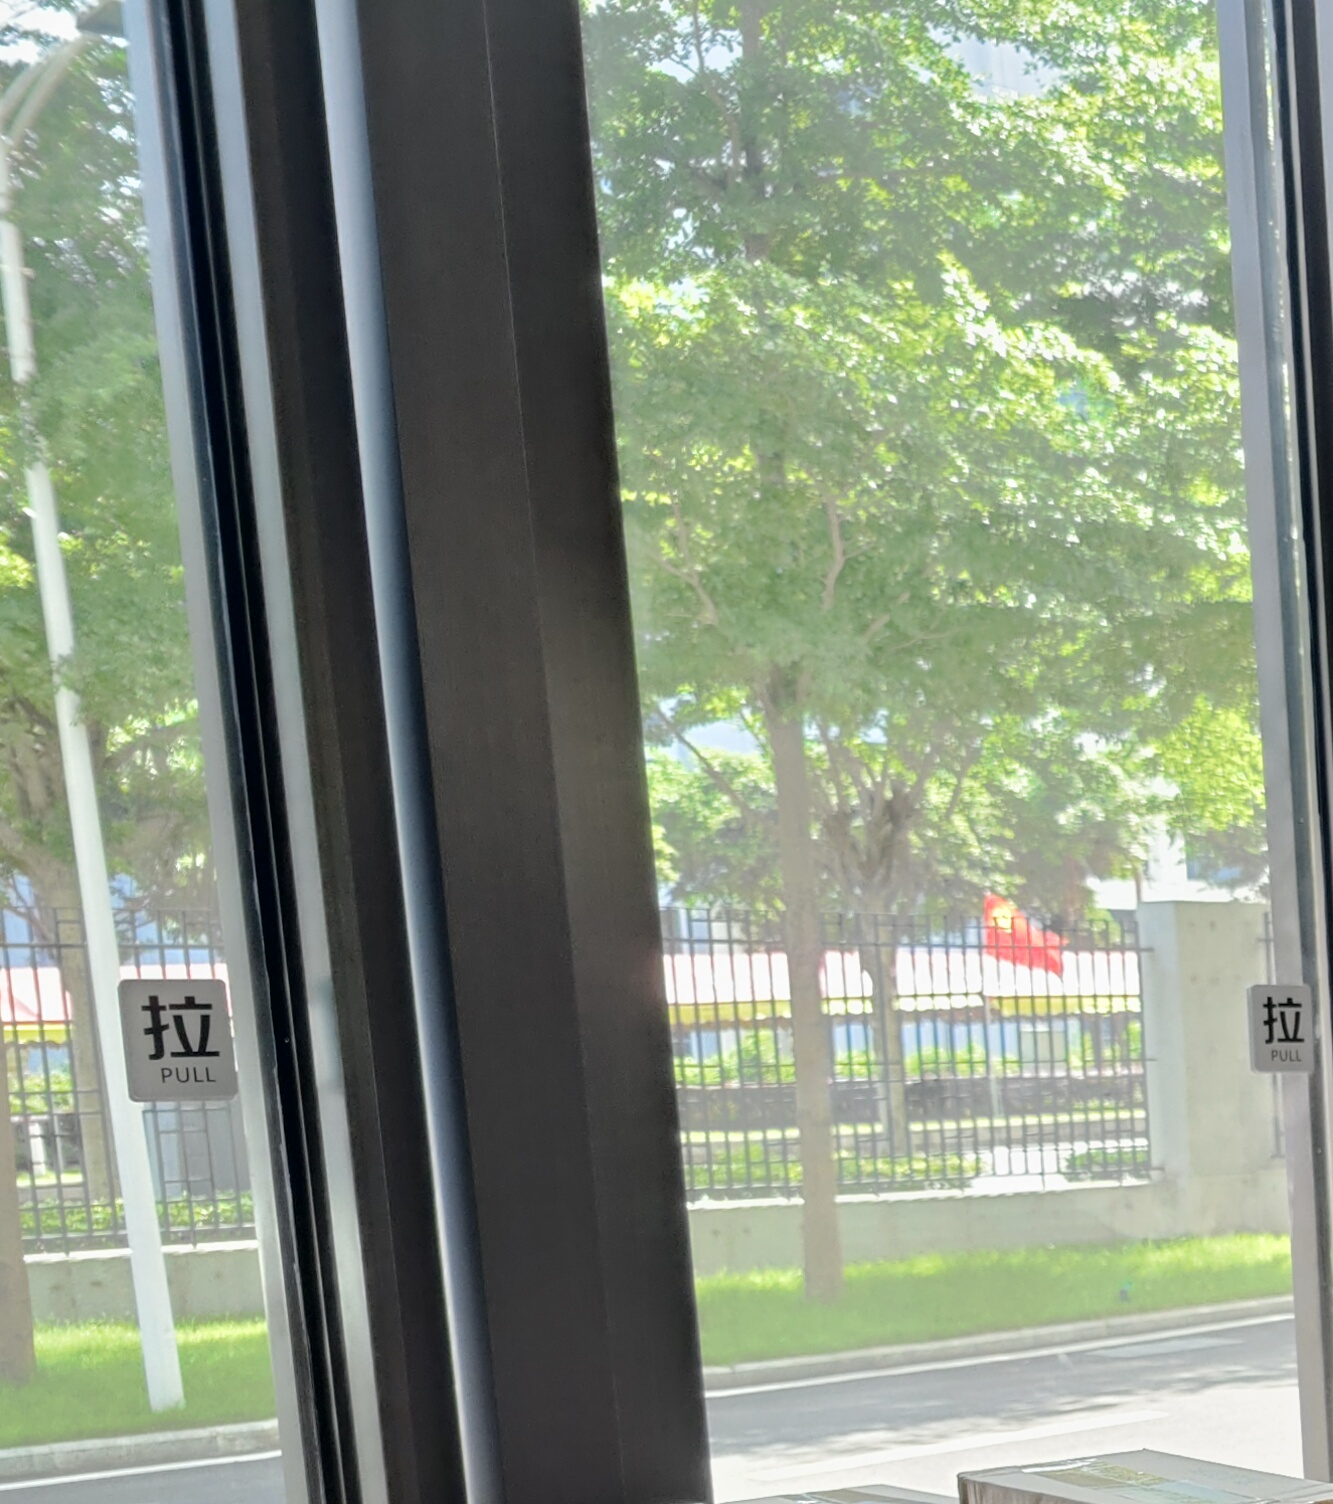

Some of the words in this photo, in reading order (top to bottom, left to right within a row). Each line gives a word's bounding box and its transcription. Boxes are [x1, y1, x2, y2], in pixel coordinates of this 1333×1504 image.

[142, 995, 220, 1060] 拉
[1263, 996, 1304, 1044] 拉
[1271, 1049, 1302, 1062] PULL
[160, 1067, 217, 1084] PULL
